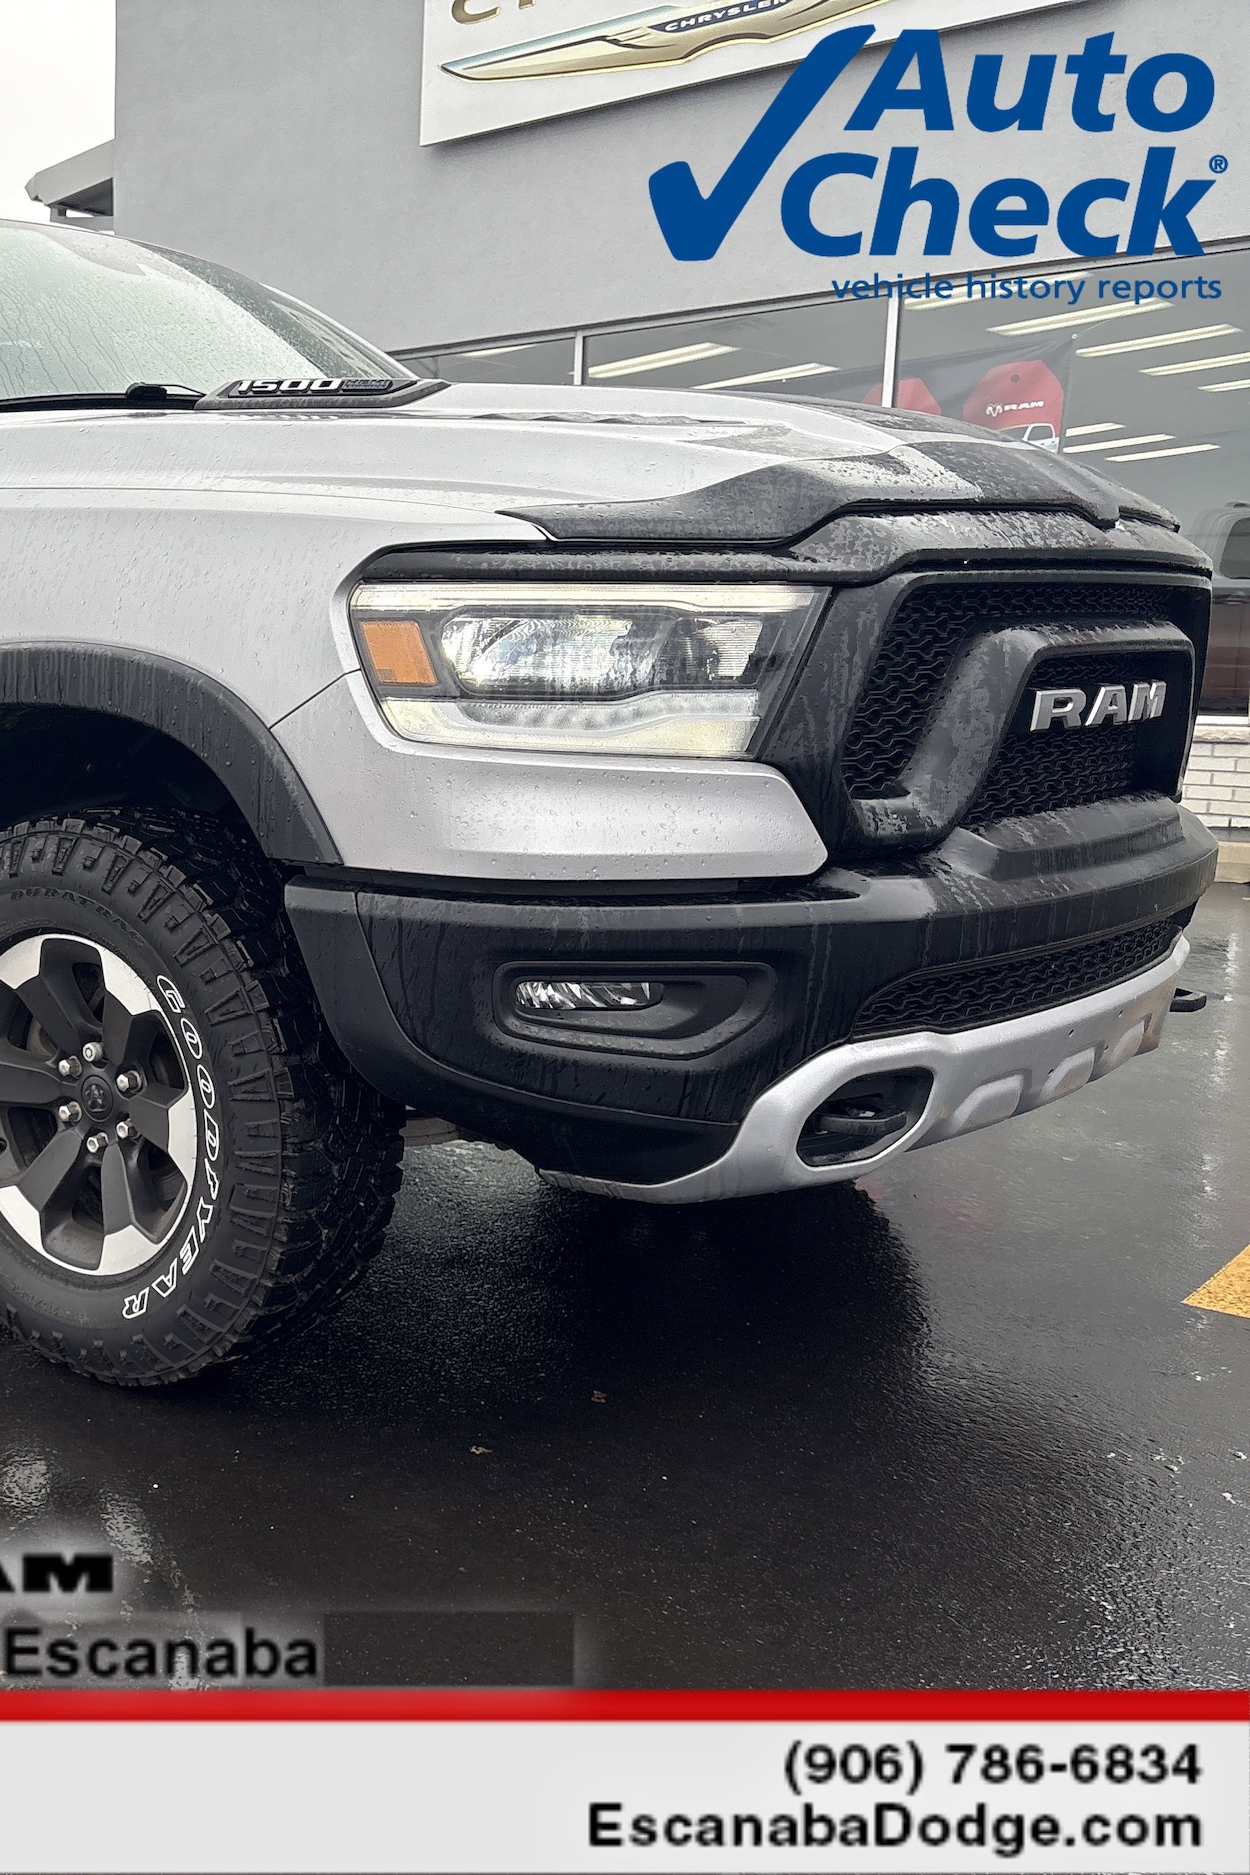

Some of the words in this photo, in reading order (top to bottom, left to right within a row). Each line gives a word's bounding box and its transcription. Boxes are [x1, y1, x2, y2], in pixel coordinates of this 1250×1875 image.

[238, 378, 343, 393] 1500
[1004, 400, 1045, 412] RAM
[1029, 680, 1167, 732] RAM
[10, 886, 147, 948] DURATRAC
[121, 974, 221, 1320] GOODYEAR
